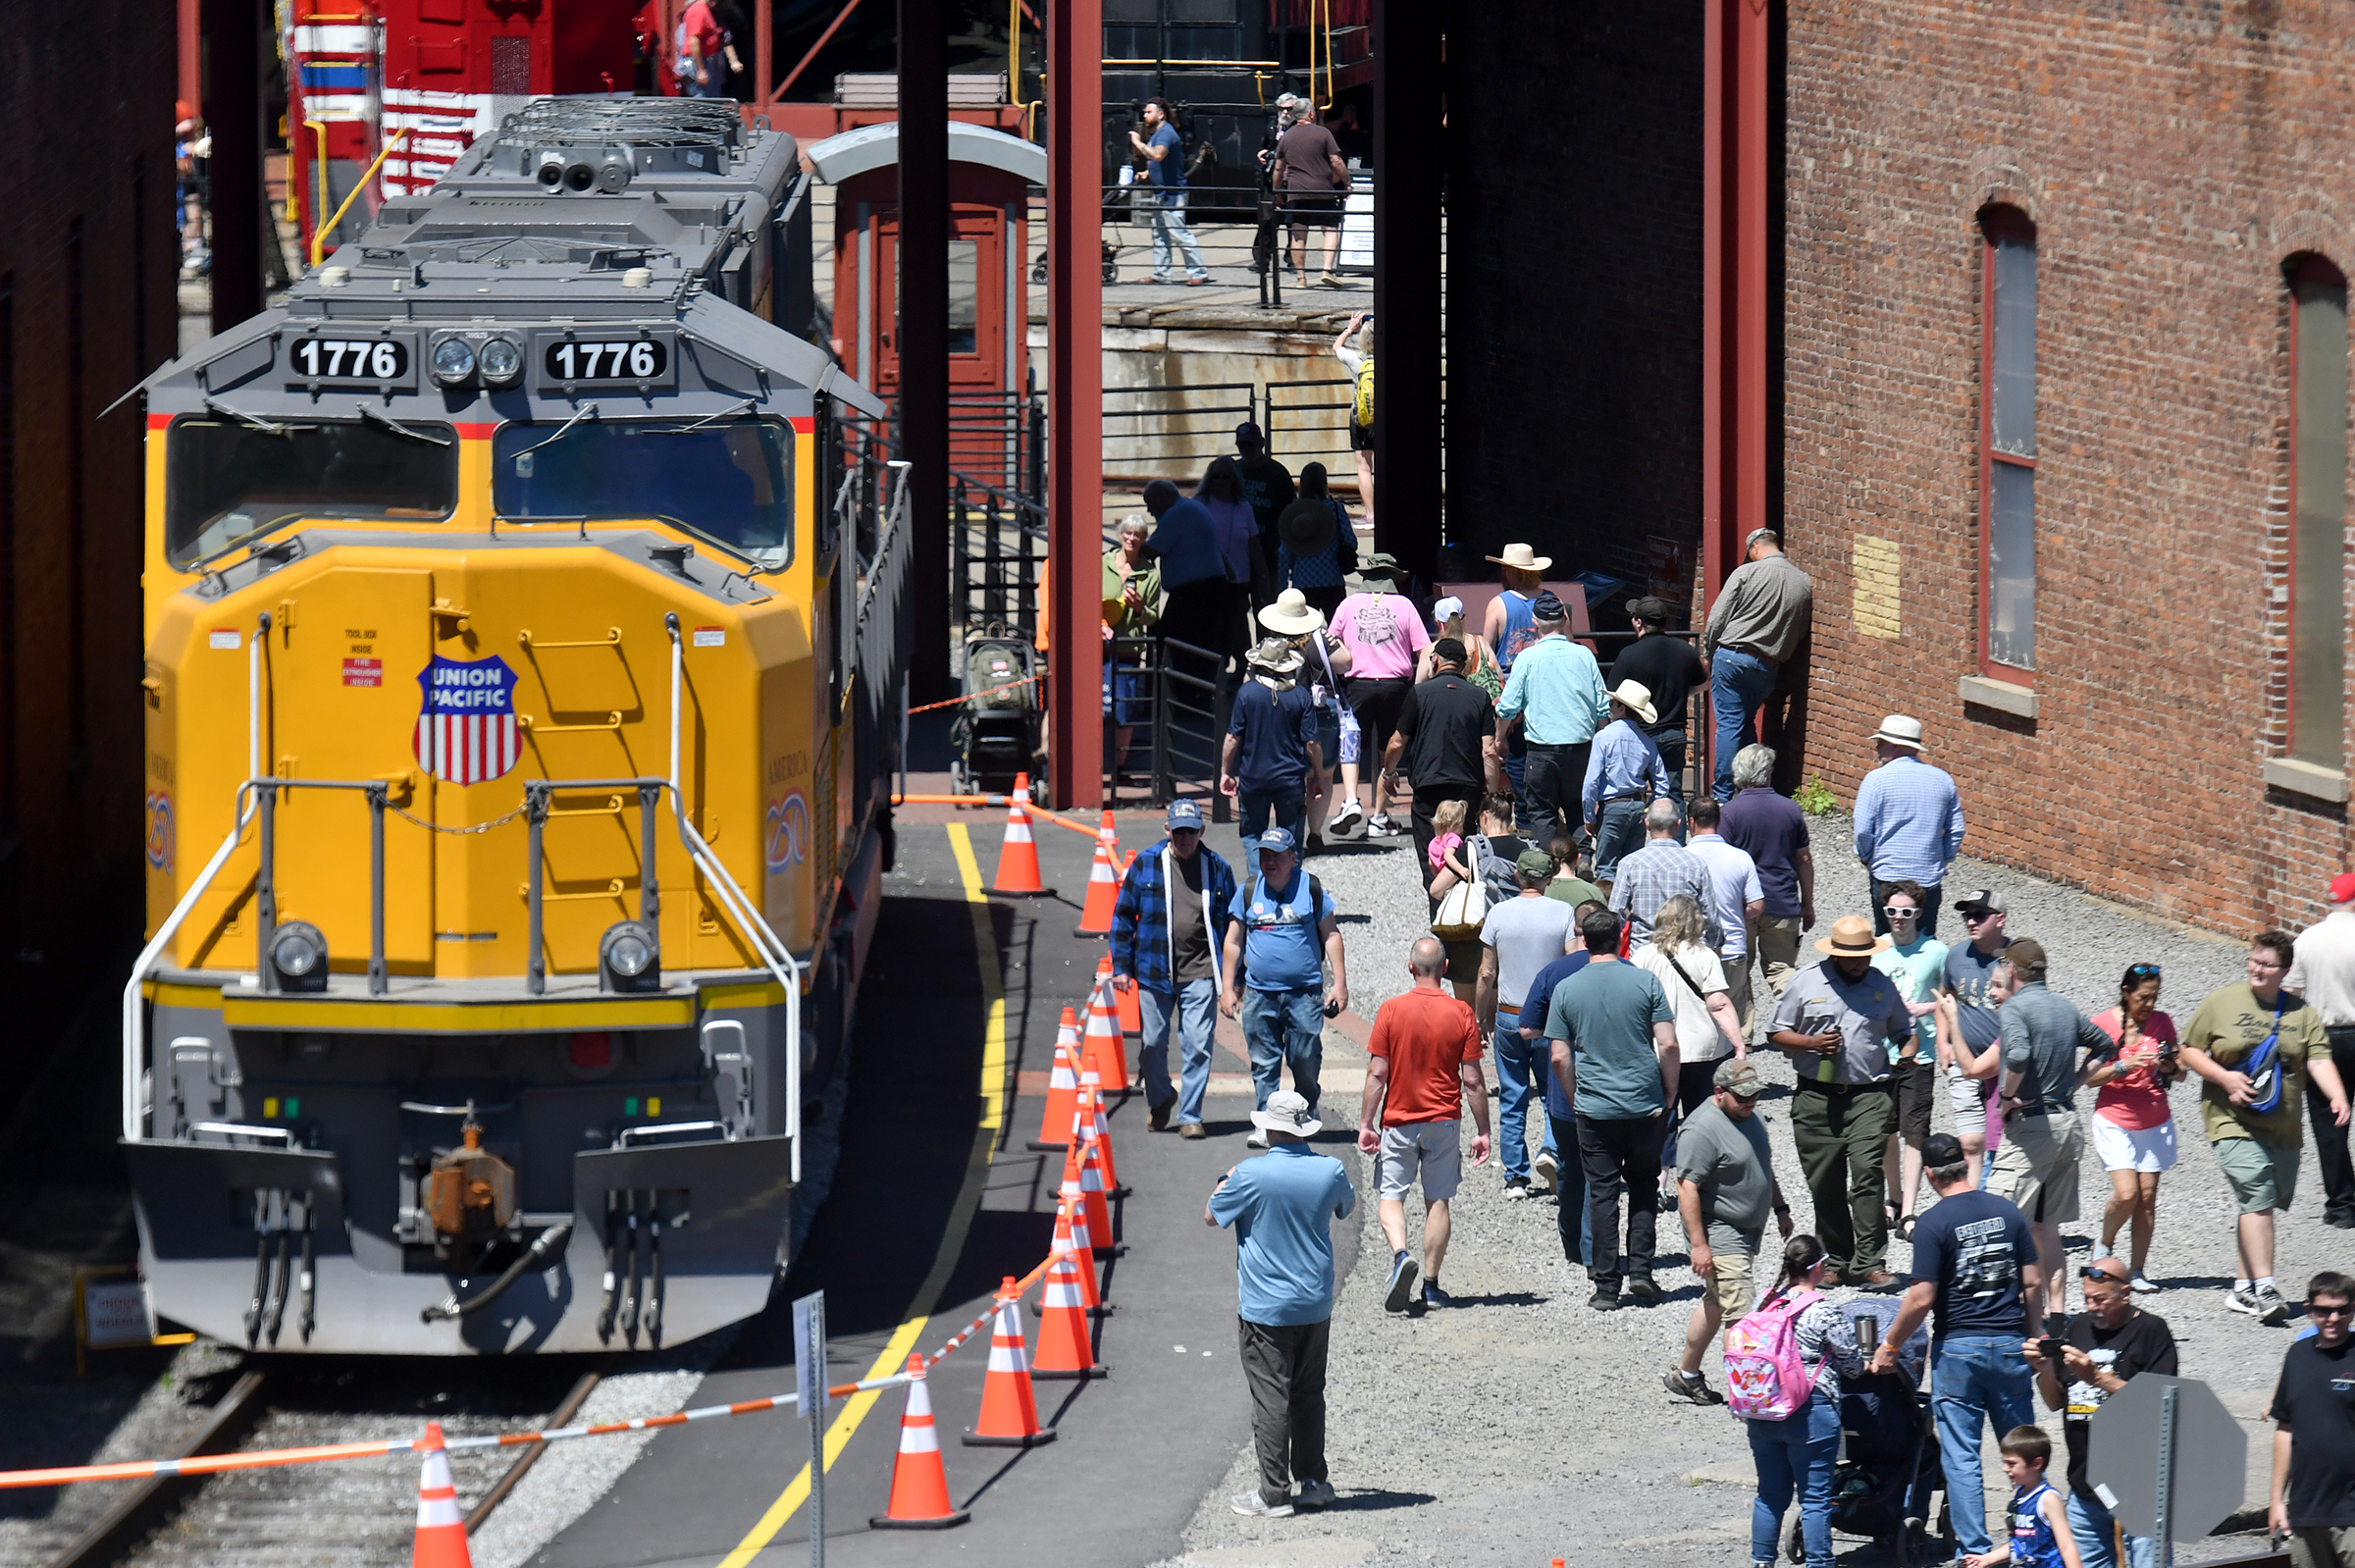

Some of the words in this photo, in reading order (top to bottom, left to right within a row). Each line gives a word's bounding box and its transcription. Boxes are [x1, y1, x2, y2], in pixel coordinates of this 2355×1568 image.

[299, 340, 397, 379] 1776
[555, 342, 655, 379] 1776
[349, 644, 372, 654] INSIDE
[353, 657, 371, 667] FIRE
[349, 677, 376, 687] INSIDE
[432, 667, 501, 687] UNION
[430, 689, 505, 708] PACIFIC
